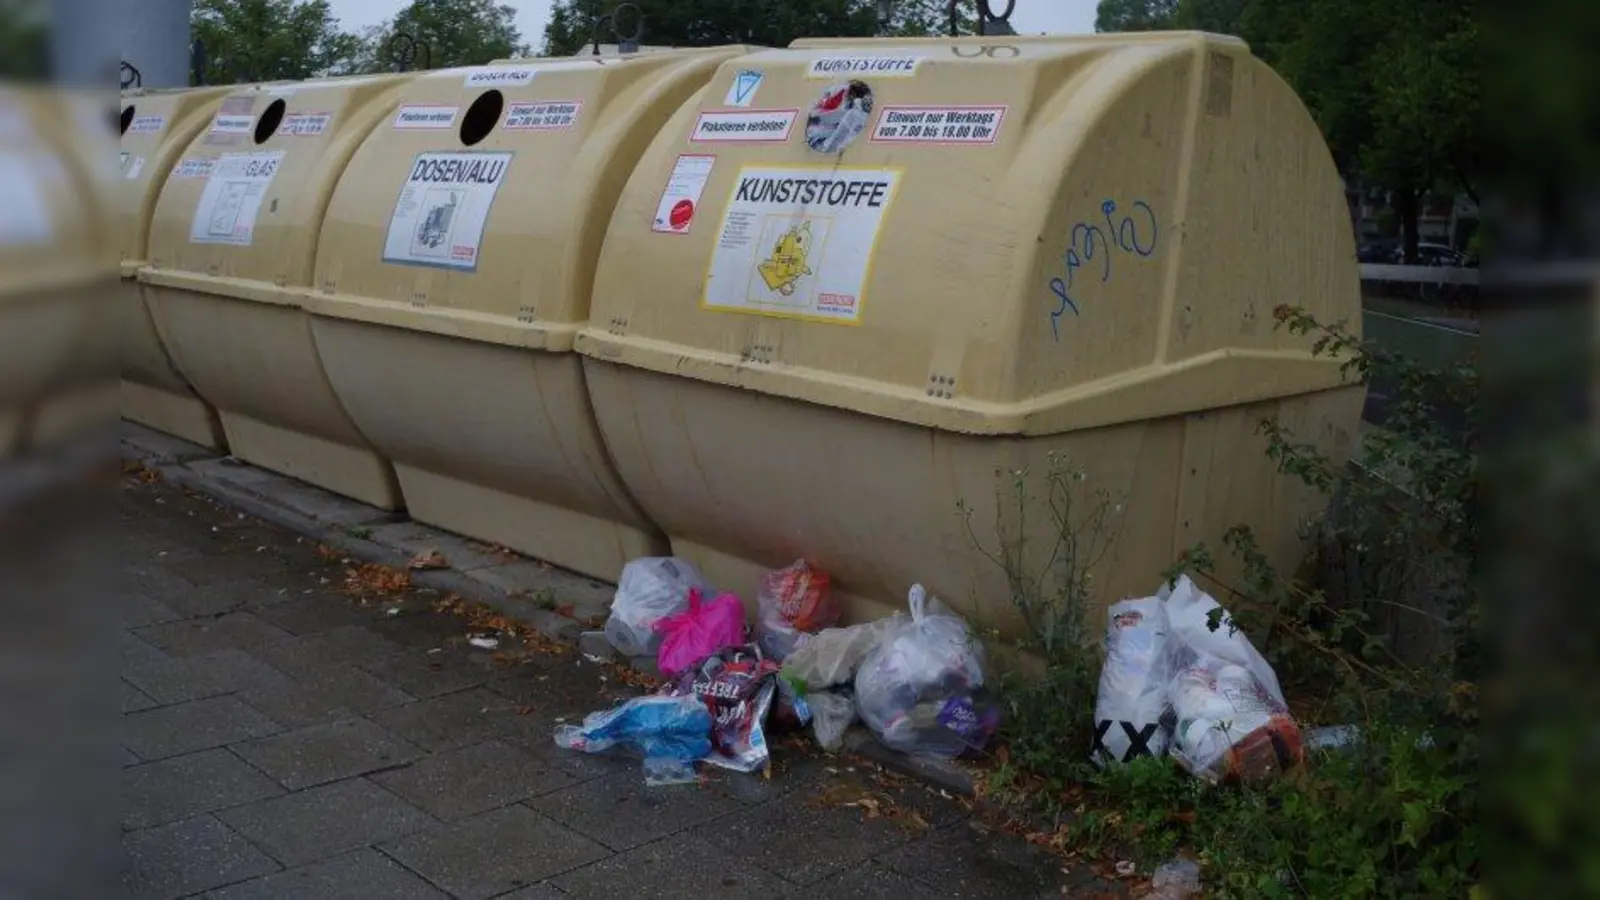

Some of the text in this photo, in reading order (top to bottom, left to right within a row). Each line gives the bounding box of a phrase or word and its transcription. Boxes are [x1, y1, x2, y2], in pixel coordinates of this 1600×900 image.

[886, 111, 995, 125] Einwurf nur Werktags
[700, 121, 746, 133] Plakatieren
[879, 126, 898, 137] von
[899, 125, 922, 137] 7.00
[922, 125, 940, 138] bis
[972, 126, 992, 138] Uhr
[410, 159, 505, 184] DOSEN/ALU
[735, 177, 888, 207] KUNSTSTOFFE
